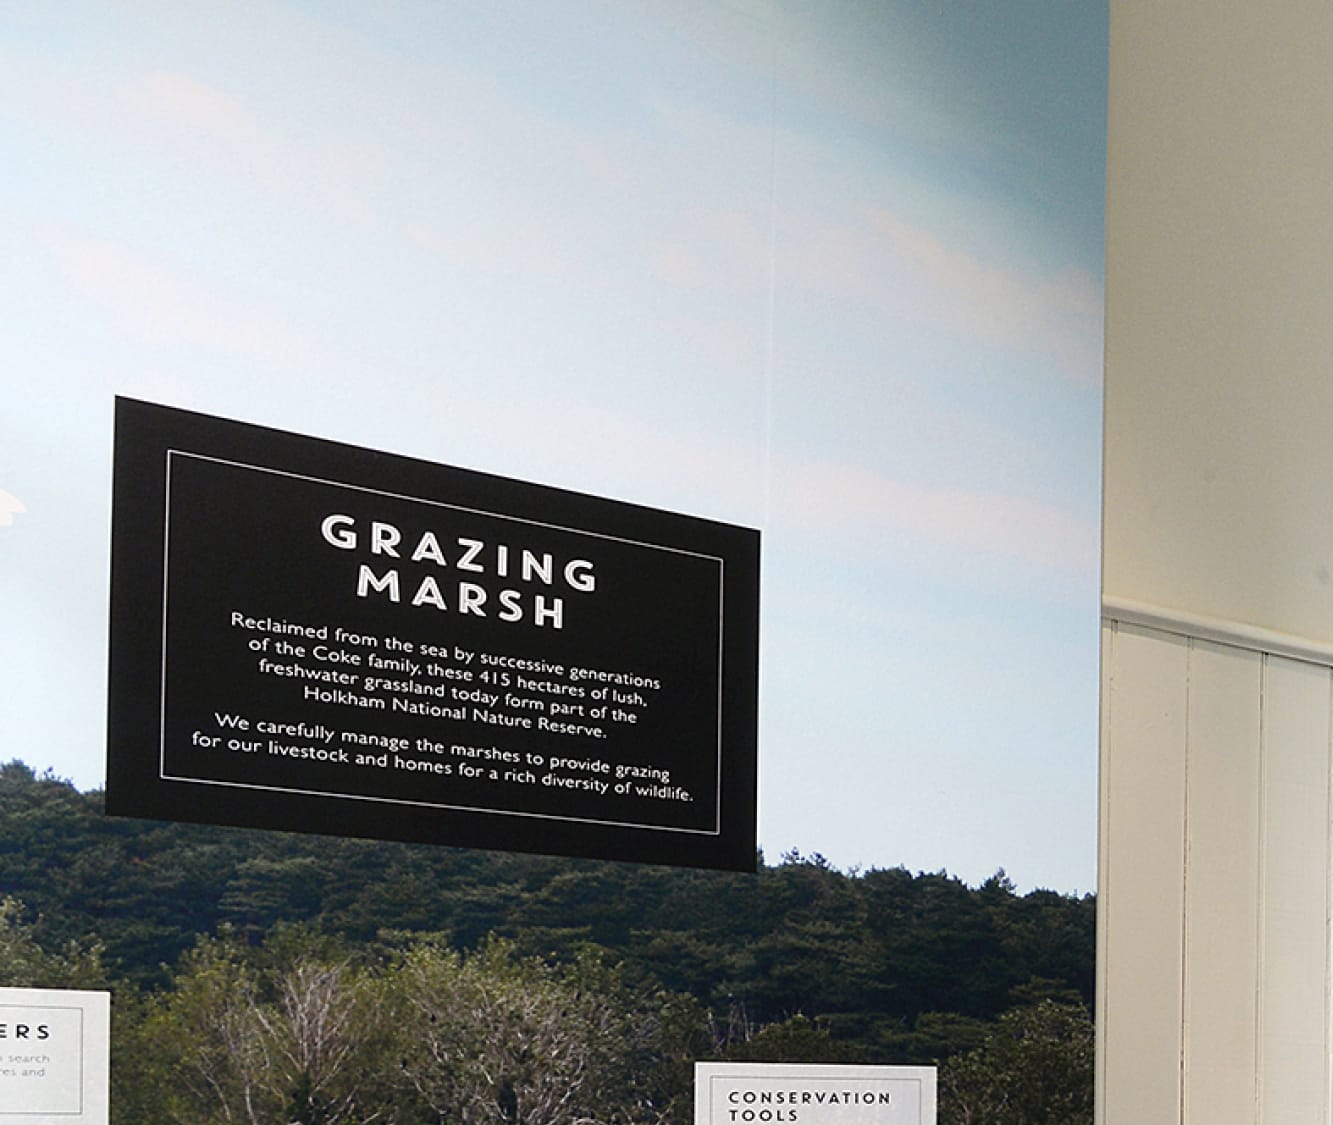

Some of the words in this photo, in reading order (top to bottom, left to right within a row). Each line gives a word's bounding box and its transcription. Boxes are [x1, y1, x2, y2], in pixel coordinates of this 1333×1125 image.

[321, 514, 595, 592] GRAZING
[356, 564, 563, 629] MARSH
[231, 611, 328, 641] Reclaimed
[334, 627, 378, 648] from
[384, 636, 414, 653] the
[419, 644, 448, 658] sea
[454, 646, 475, 665] by
[480, 653, 565, 676] successive
[569, 667, 661, 690] generations
[248, 637, 271, 652] of
[274, 640, 306, 658] the
[312, 645, 362, 666] Coke
[426, 663, 473, 682] these
[479, 670, 511, 687] 415
[517, 675, 585, 698] hectares
[590, 686, 609, 700] of
[258, 657, 360, 685] freshwater
[363, 676, 445, 698] grassland
[451, 687, 499, 708] today
[504, 692, 545, 711] form
[550, 702, 585, 717] part
[590, 705, 609, 719] of
[611, 708, 637, 724] the
[304, 685, 385, 709] Holkham
[392, 697, 467, 720] National
[473, 708, 532, 729] Nature
[537, 716, 607, 739] Reserve.
[192, 730, 222, 748] for
[227, 739, 262, 753] our
[268, 740, 350, 763] livestock
[354, 754, 388, 768] and
[394, 754, 453, 775] homes
[458, 762, 484, 778] for
[488, 769, 499, 780] a
[504, 768, 536, 784] rich
[541, 773, 609, 795] diversity
[614, 781, 633, 795] of
[635, 784, 694, 802] wildlife.
[214, 712, 250, 731] We
[256, 721, 335, 744] carefully
[341, 732, 409, 753] manage
[415, 738, 445, 754] the
[450, 745, 521, 763] marshes
[525, 752, 545, 766] to
[549, 757, 611, 774] provide
[615, 764, 670, 785] grazing
[0, 1023, 50, 1040] ERS
[728, 1091, 890, 1105] CONSERVATION
[729, 1109, 797, 1122] TOOLS
